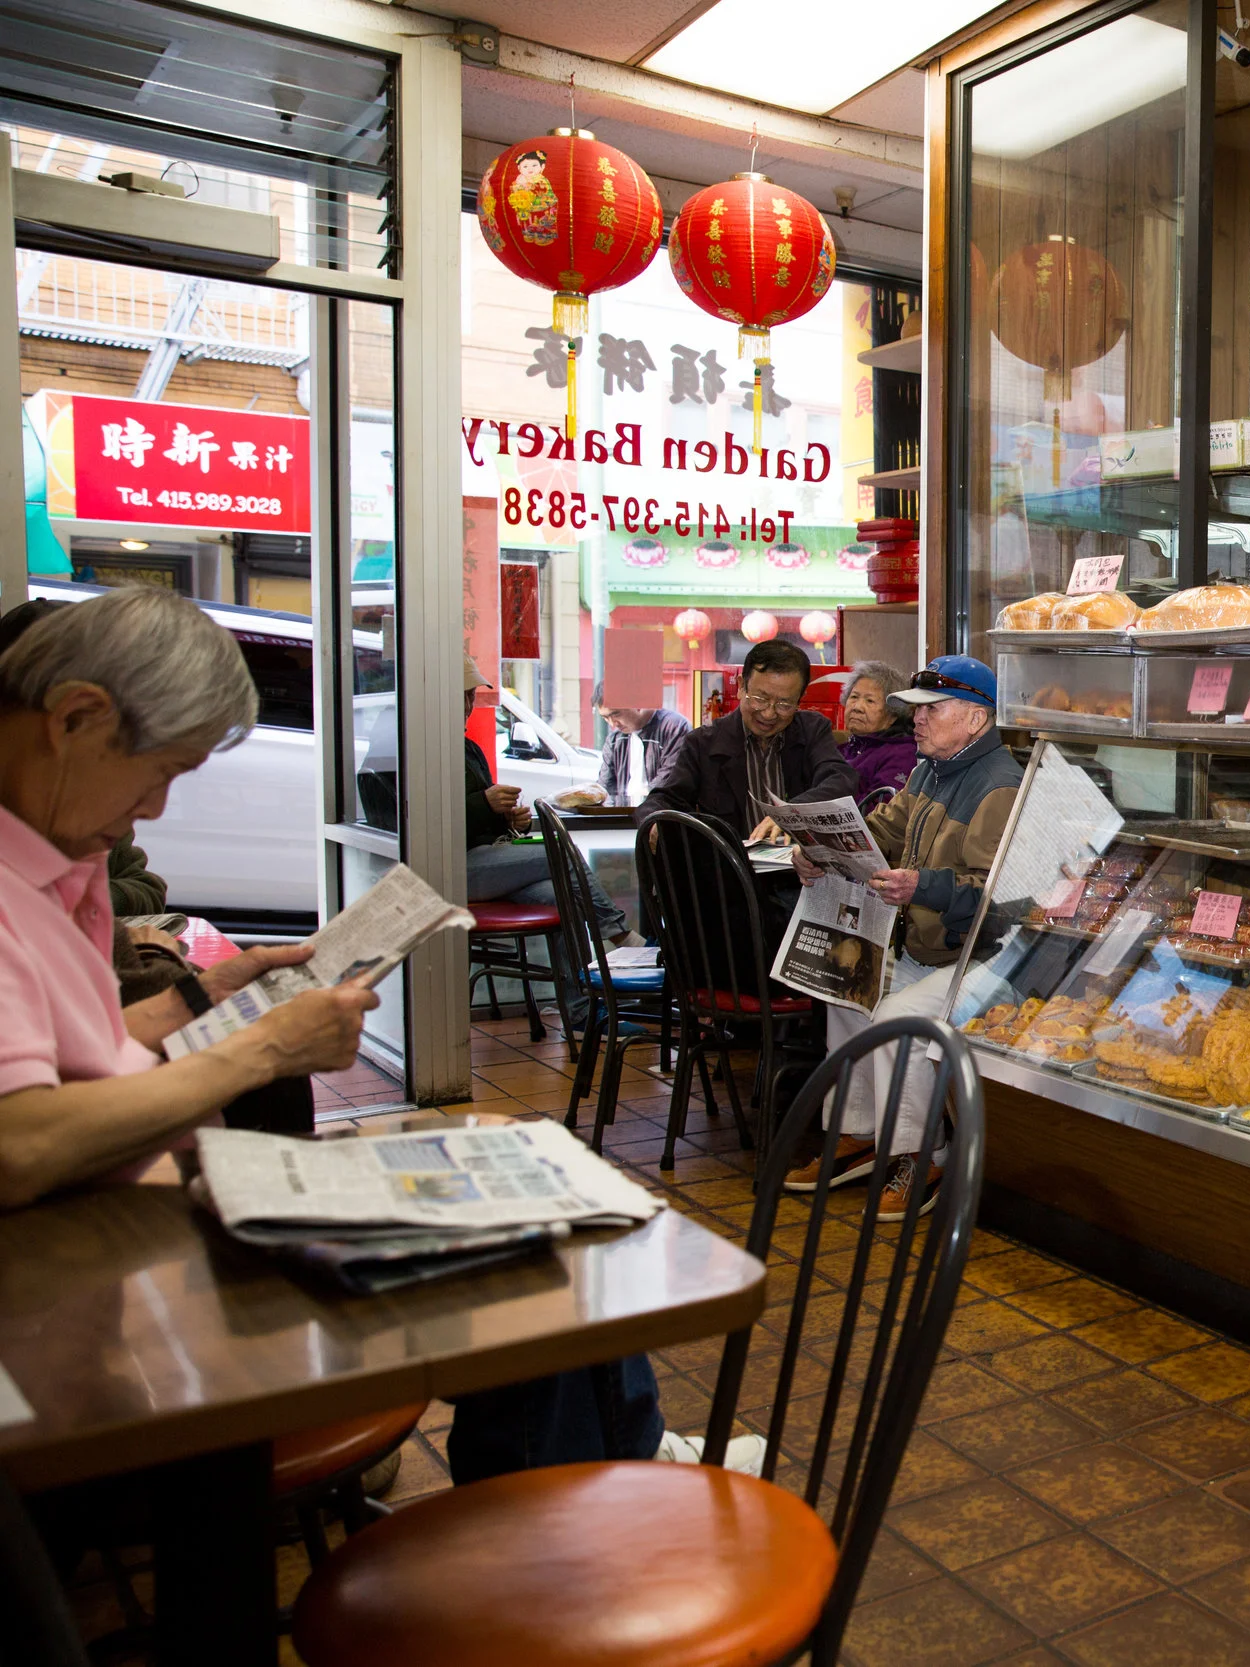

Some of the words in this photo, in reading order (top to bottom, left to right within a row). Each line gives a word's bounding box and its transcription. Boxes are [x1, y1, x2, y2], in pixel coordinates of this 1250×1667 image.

[593, 157, 620, 255] 恭喜發財
[705, 198, 731, 289] 恭喜發財
[101, 417, 294, 474] 時新果汁
[116, 486, 153, 508] Tel.
[156, 489, 283, 516] 415.989.3028
